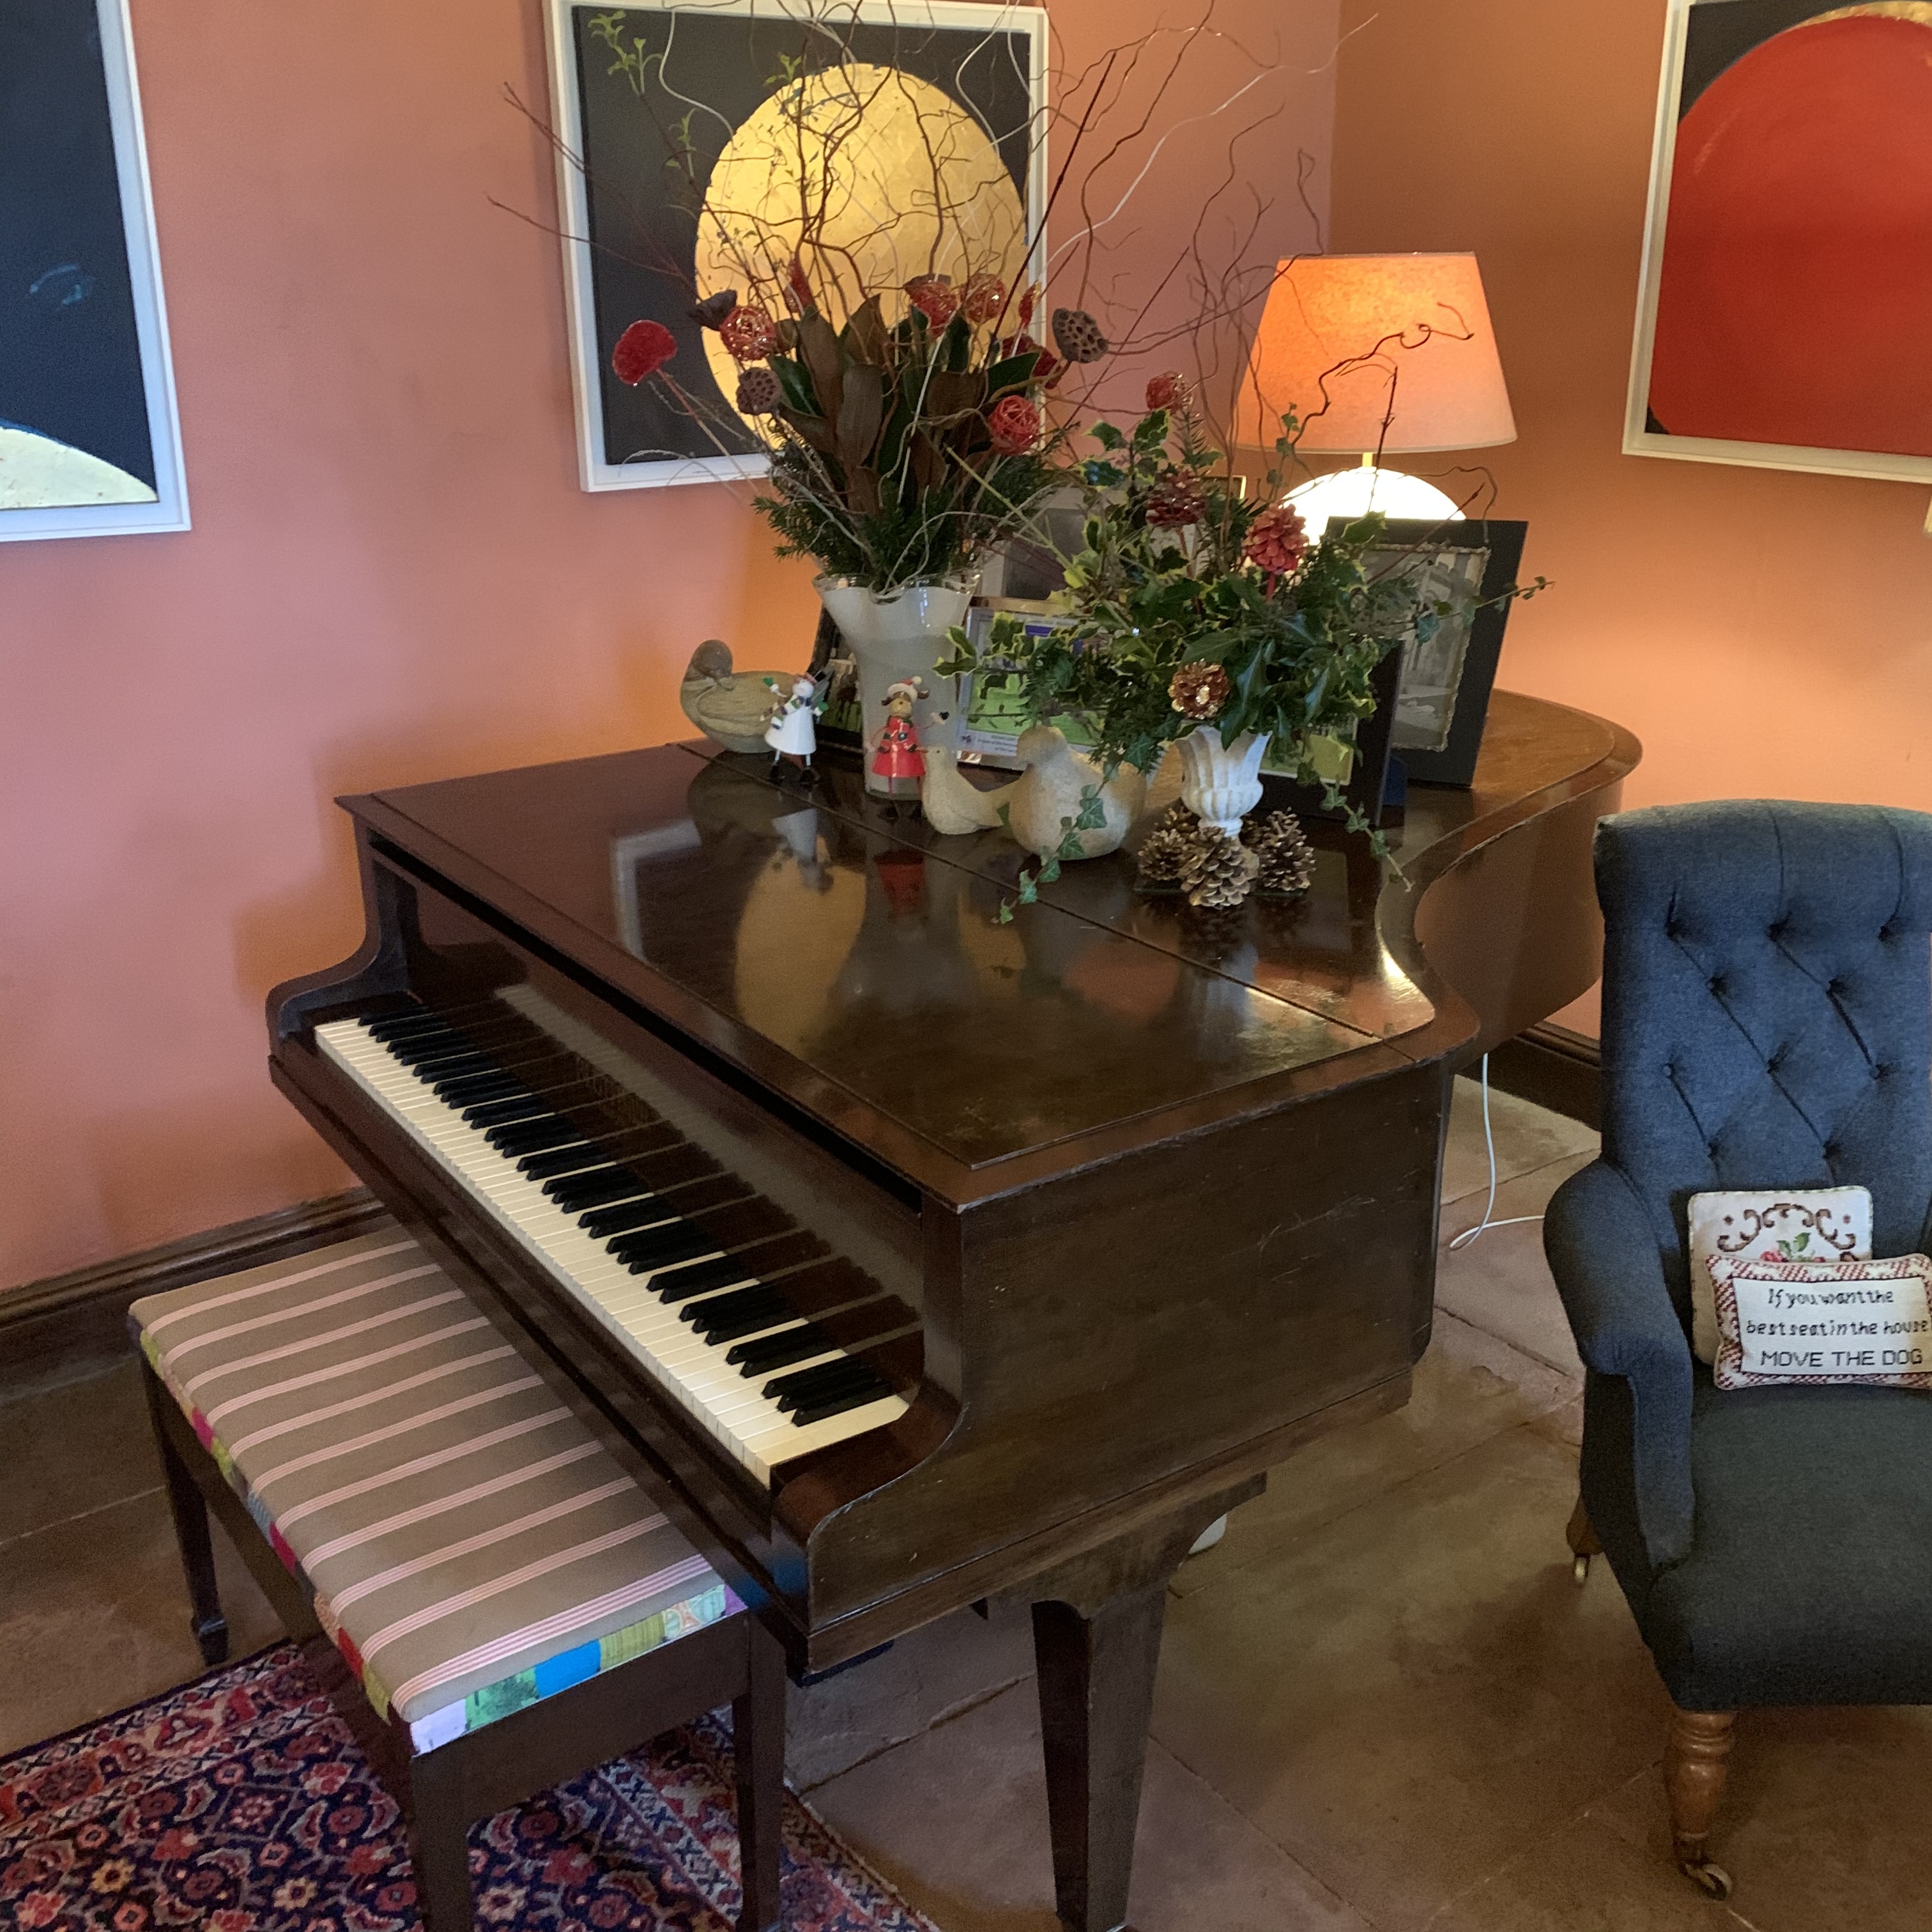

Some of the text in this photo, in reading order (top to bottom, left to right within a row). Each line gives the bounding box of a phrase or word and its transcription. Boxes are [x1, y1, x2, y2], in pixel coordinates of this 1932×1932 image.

[1768, 1288, 1894, 1308] If you want the
[1746, 1320, 1928, 1335] best seat in the house
[1761, 1348, 1923, 1367] MOVE THE DOG
